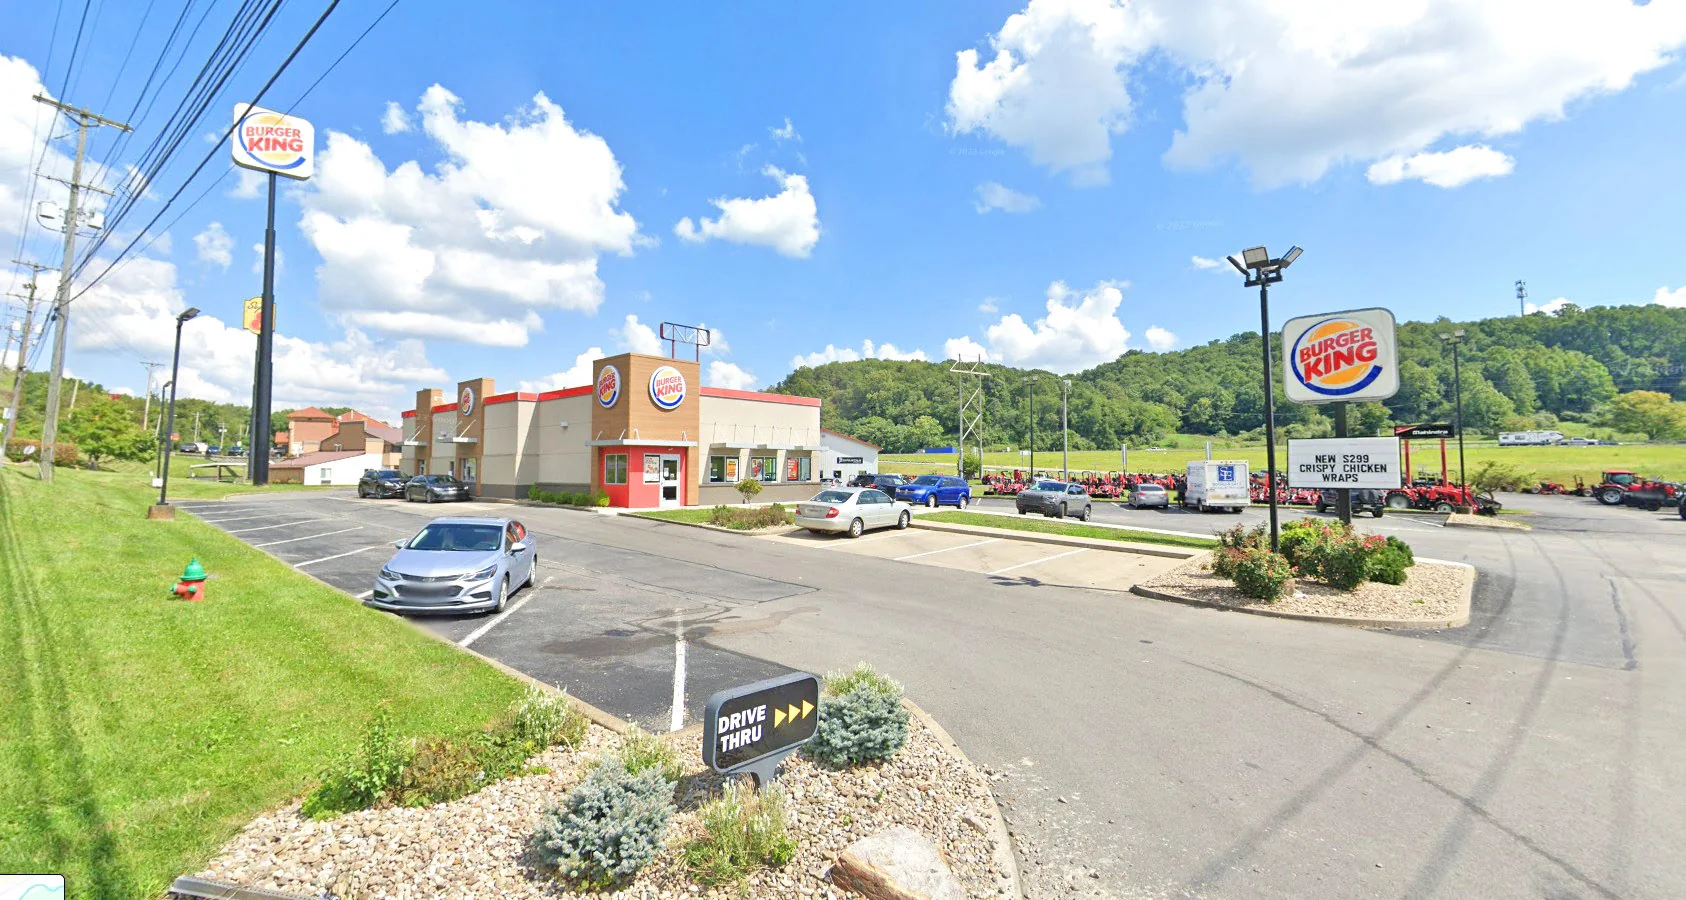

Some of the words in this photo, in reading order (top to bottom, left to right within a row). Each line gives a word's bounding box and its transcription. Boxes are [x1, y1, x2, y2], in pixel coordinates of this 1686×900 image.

[246, 126, 301, 138] BURGER
[248, 137, 303, 152] KING
[1300, 327, 1374, 363] BURGER
[1303, 341, 1377, 383] KING
[599, 379, 616, 398] KING
[656, 376, 682, 387] BURGER
[656, 383, 683, 398] KING
[1315, 455, 1336, 463] NEW
[1299, 464, 1336, 472] CRISPY
[1343, 464, 1387, 472] CHICKEN
[1322, 474, 1358, 482] WRAPS
[718, 705, 767, 734] DRIVE
[721, 726, 762, 752] THRU
